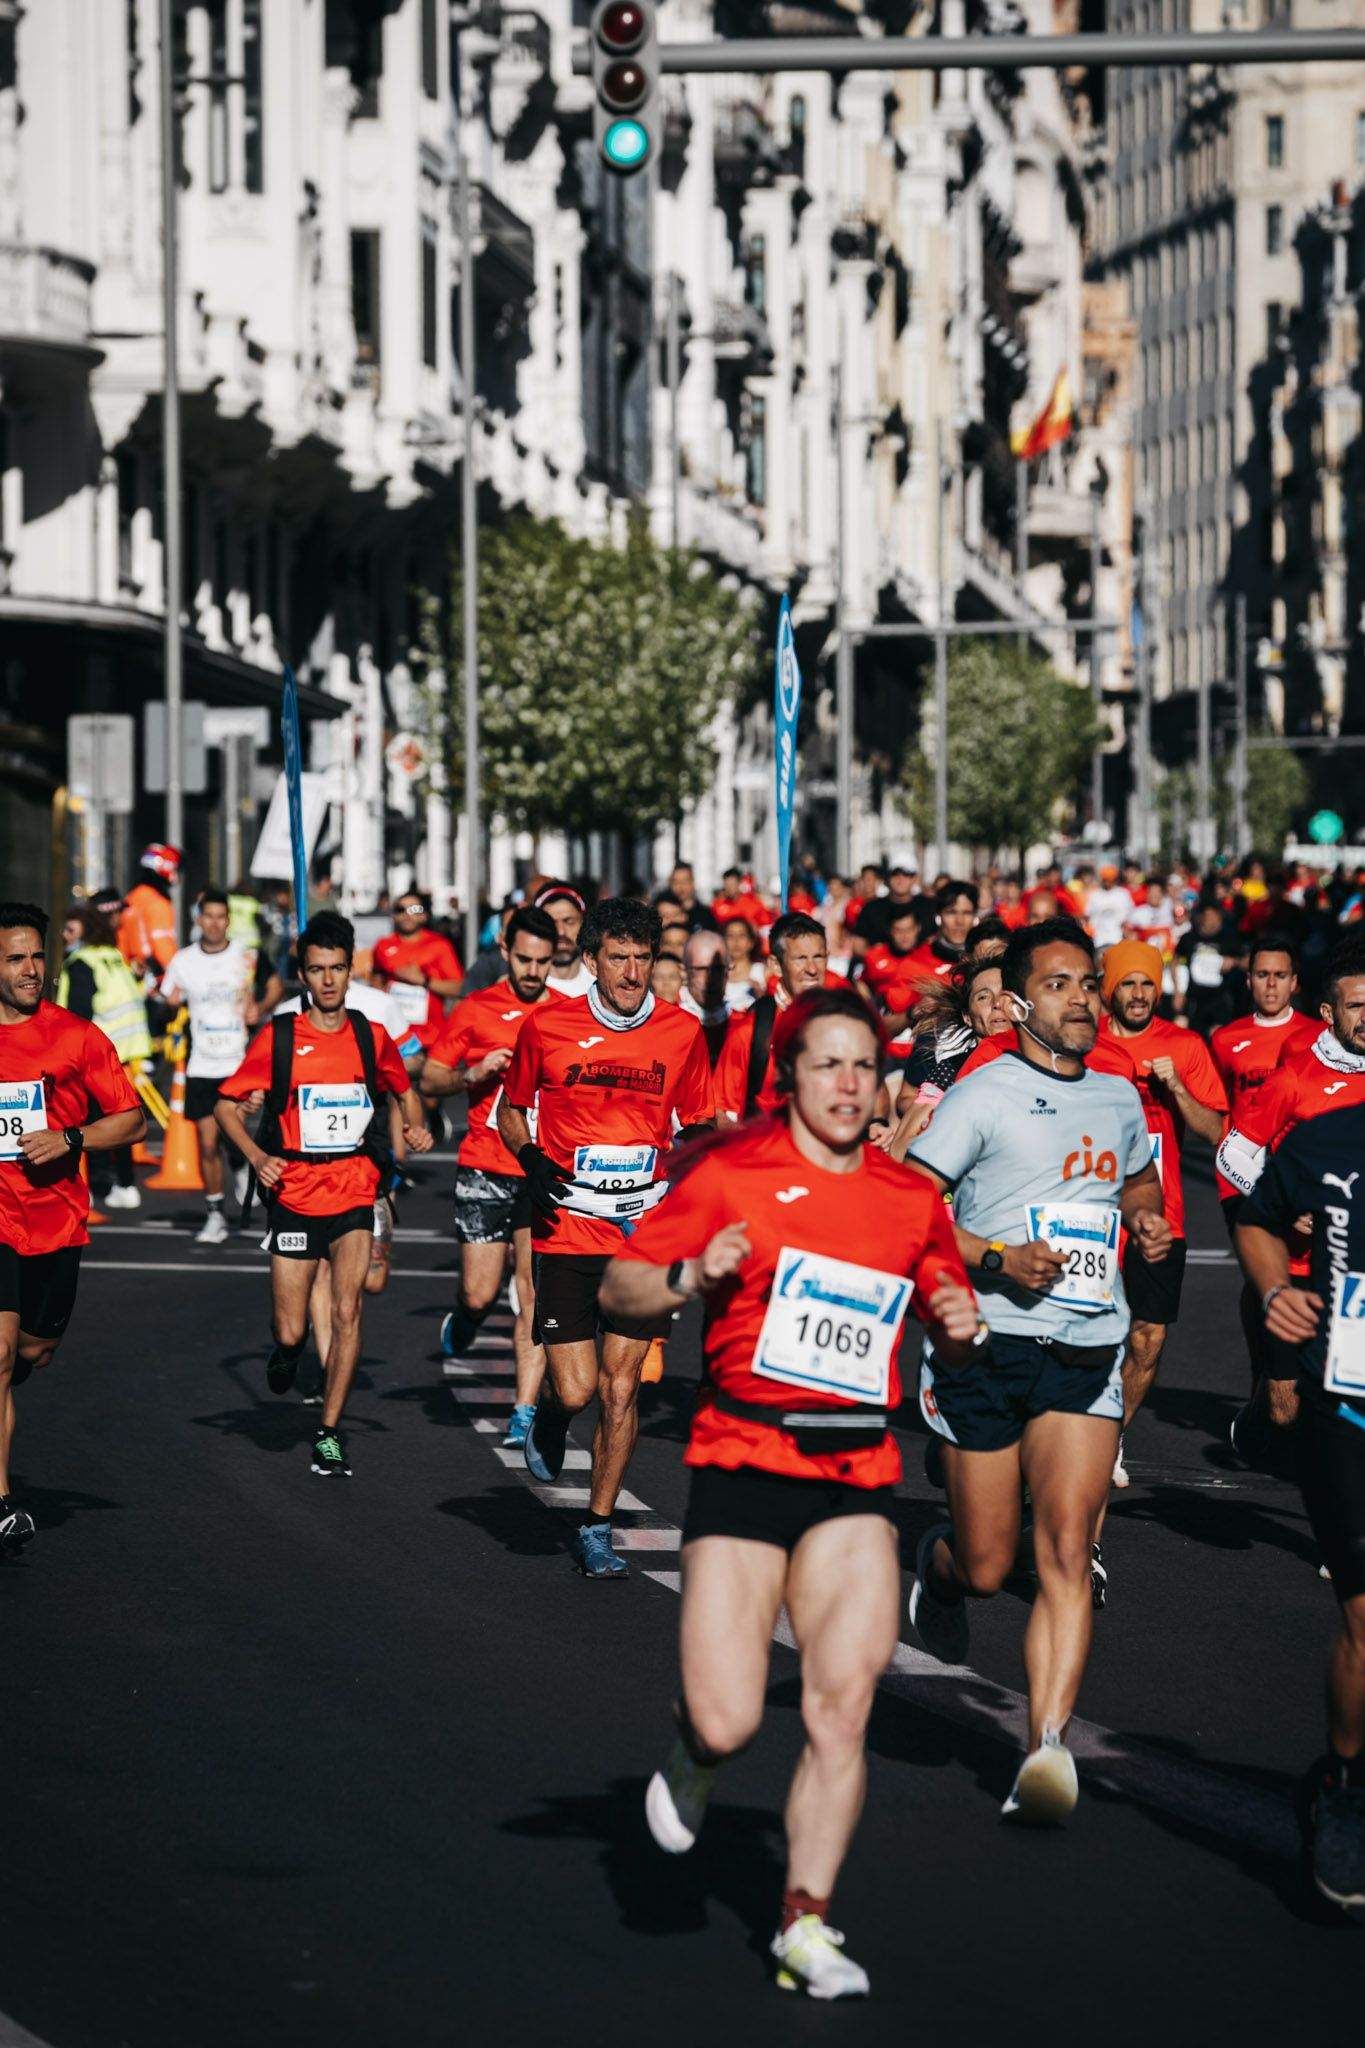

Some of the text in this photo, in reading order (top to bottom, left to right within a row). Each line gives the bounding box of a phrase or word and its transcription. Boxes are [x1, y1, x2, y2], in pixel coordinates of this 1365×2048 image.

[590, 1065, 662, 1083] BOMBEROS
[326, 1114, 348, 1131] 21
[1062, 1134, 1118, 1184] ria
[280, 1236, 305, 1247] 6839
[1057, 1247, 1107, 1280] 289
[796, 1312, 872, 1358] 1069
